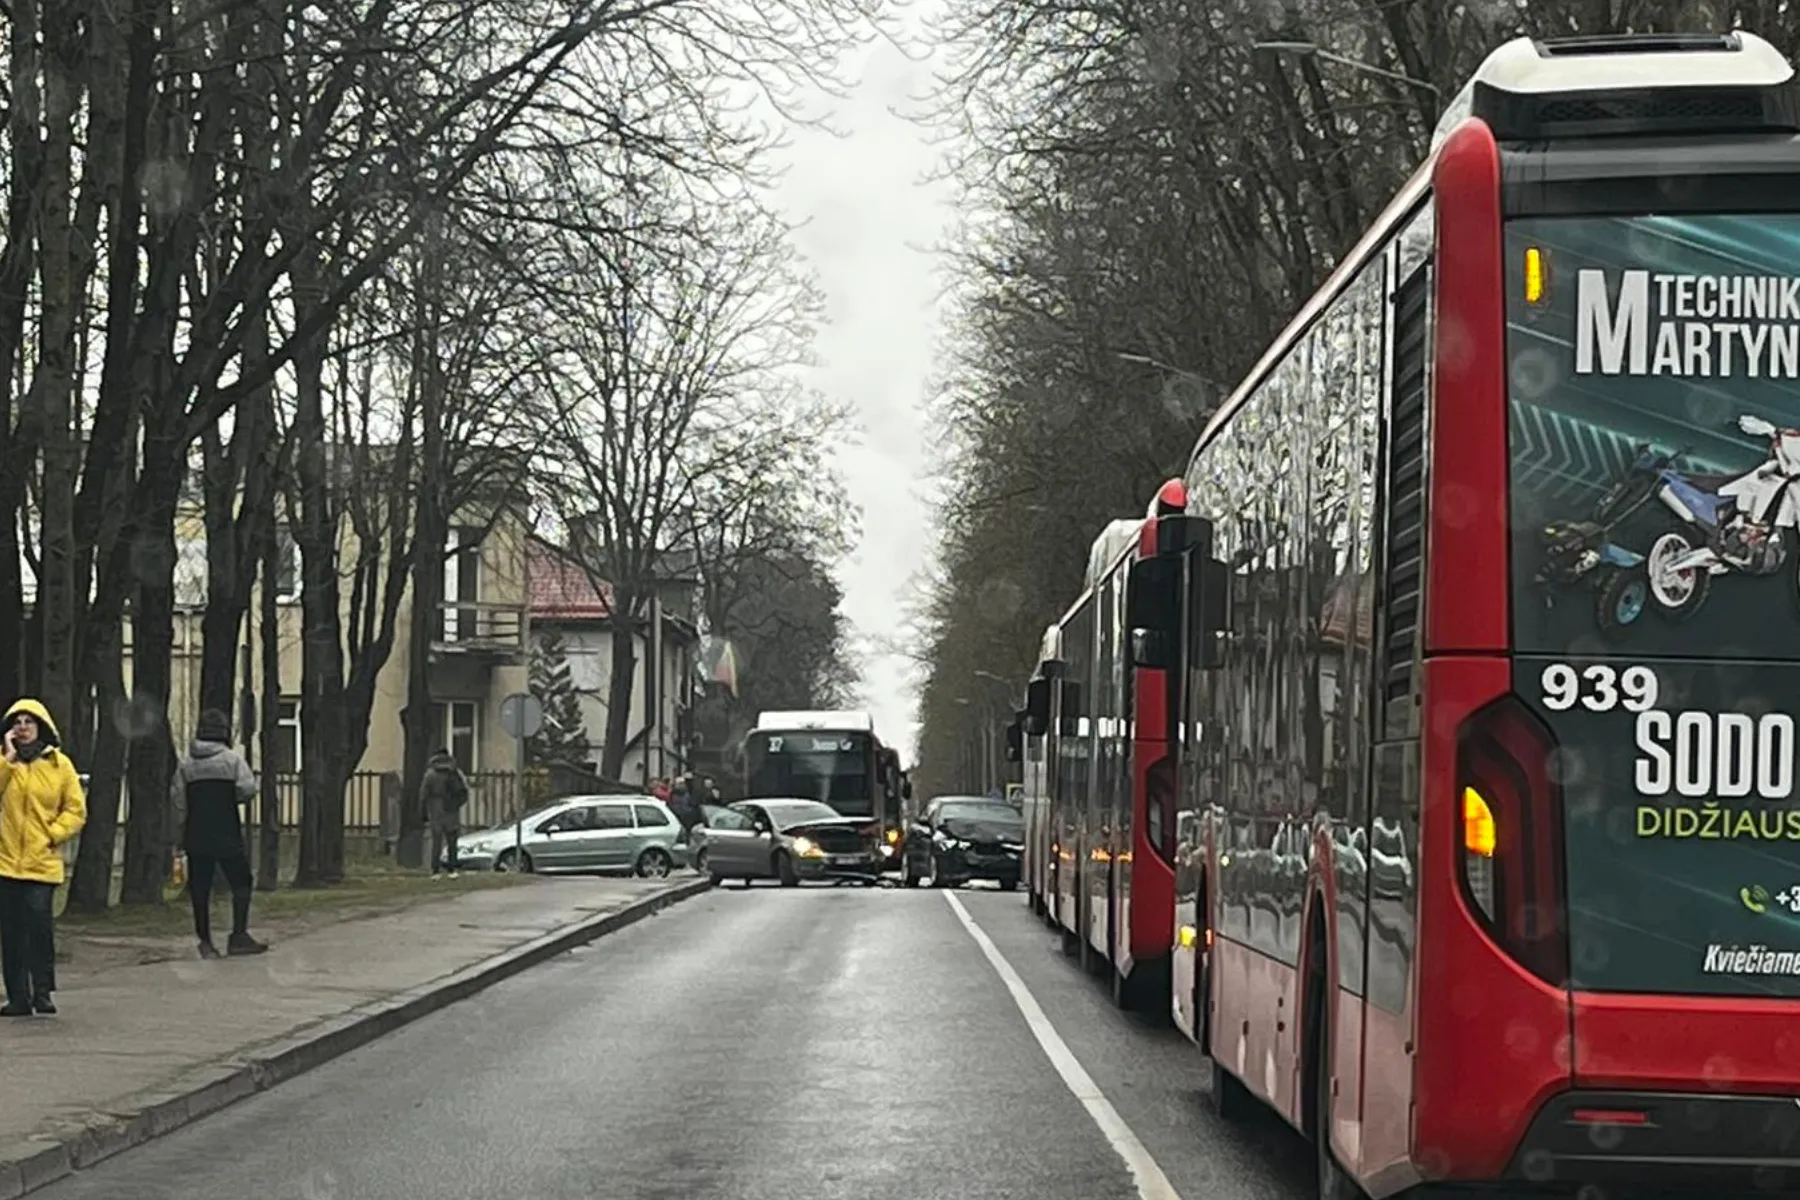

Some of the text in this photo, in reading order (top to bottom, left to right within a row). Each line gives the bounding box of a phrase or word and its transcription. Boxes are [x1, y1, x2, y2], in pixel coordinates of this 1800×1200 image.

[1653, 274, 1800, 320] TECHNIK
[1541, 664, 1658, 712] 939
[1635, 710, 1794, 798] SODO
[1703, 944, 1800, 975] Kviečiame
